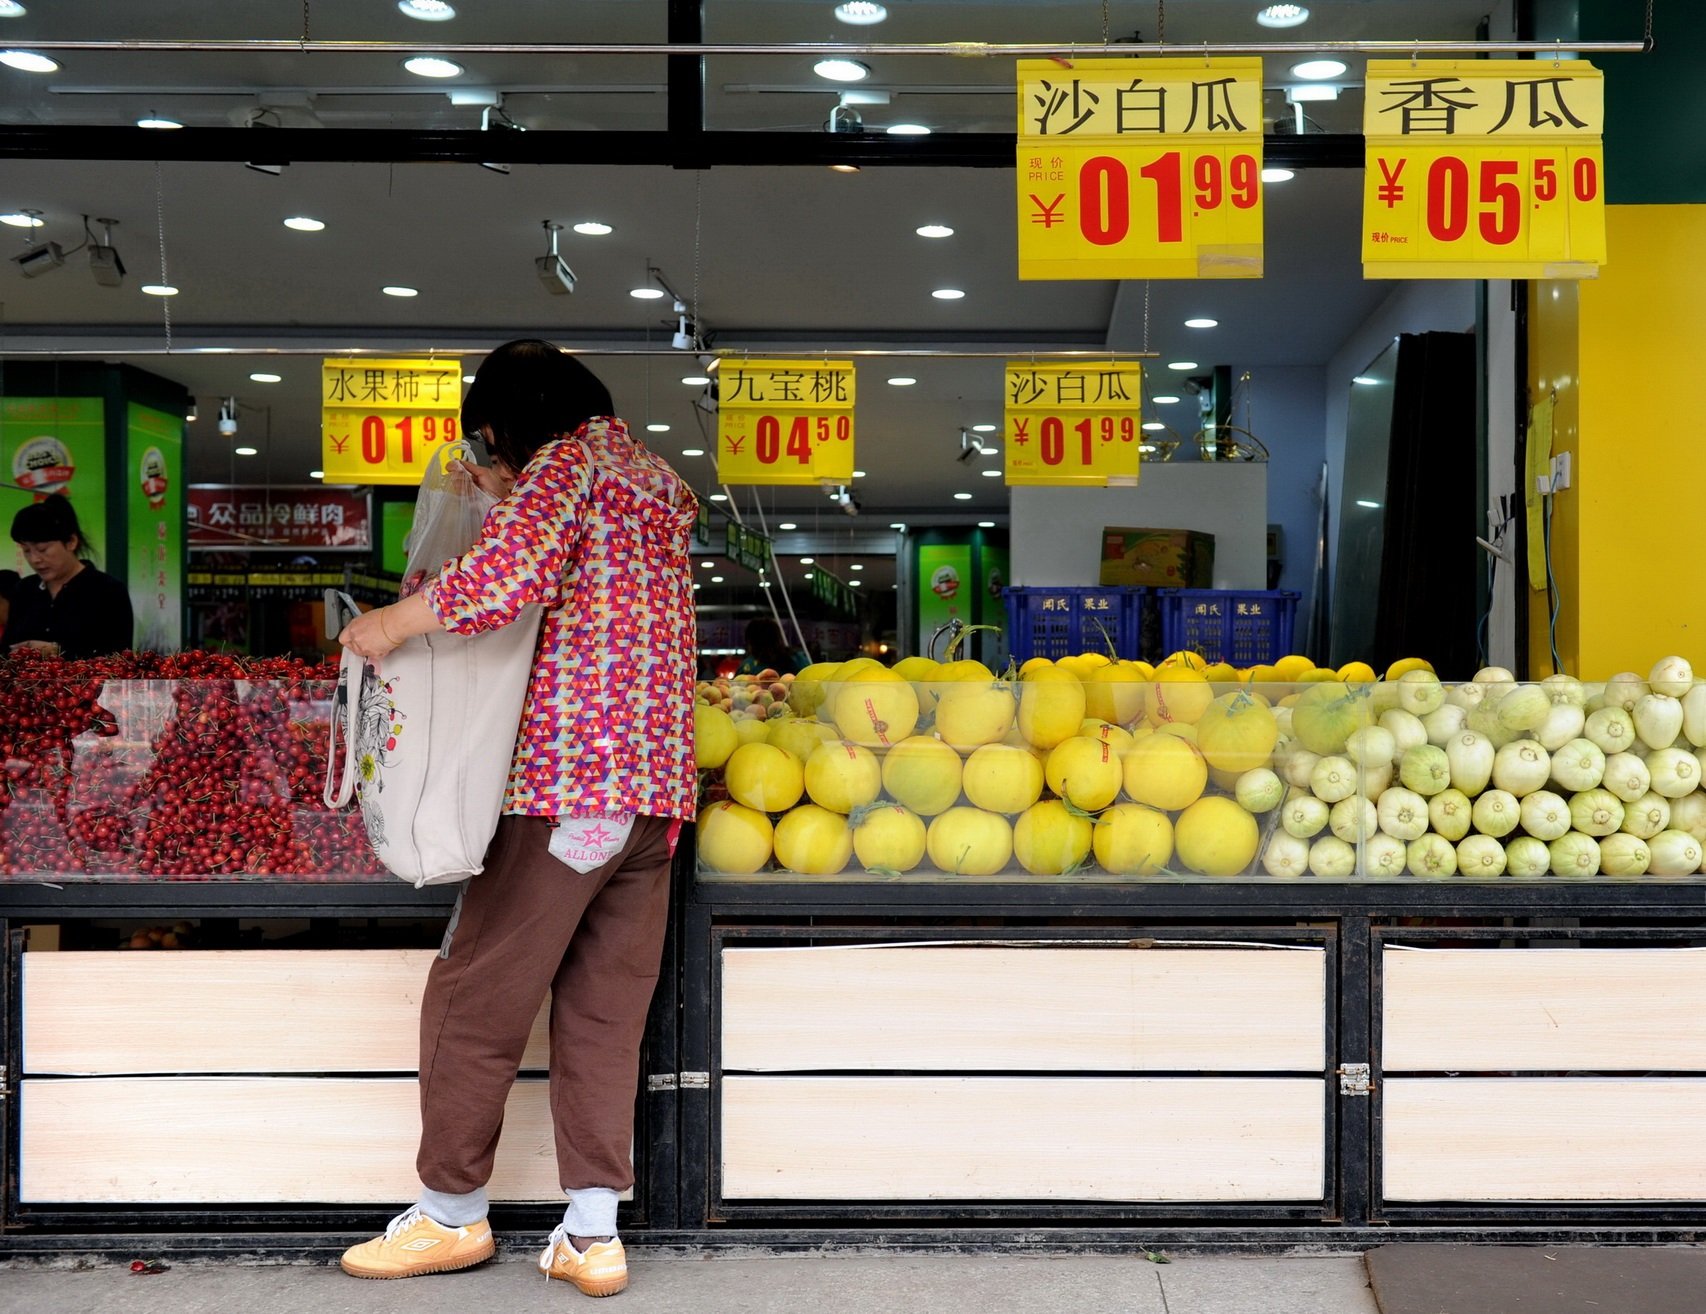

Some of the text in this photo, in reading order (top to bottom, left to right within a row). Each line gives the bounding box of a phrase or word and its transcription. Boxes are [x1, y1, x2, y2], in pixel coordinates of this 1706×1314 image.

[1034, 78, 1247, 134] 沙白瓜
[1379, 78, 1589, 134] 香瓜
[1028, 157, 1064, 171] 现价
[1028, 171, 1064, 182] PRICE
[328, 369, 451, 402] 水果柿子
[727, 371, 849, 402] 九宝桃
[1010, 371, 1131, 405] 沙白瓜
[208, 502, 344, 526] 众品冷鲜肉
[564, 848, 588, 861] ALL
